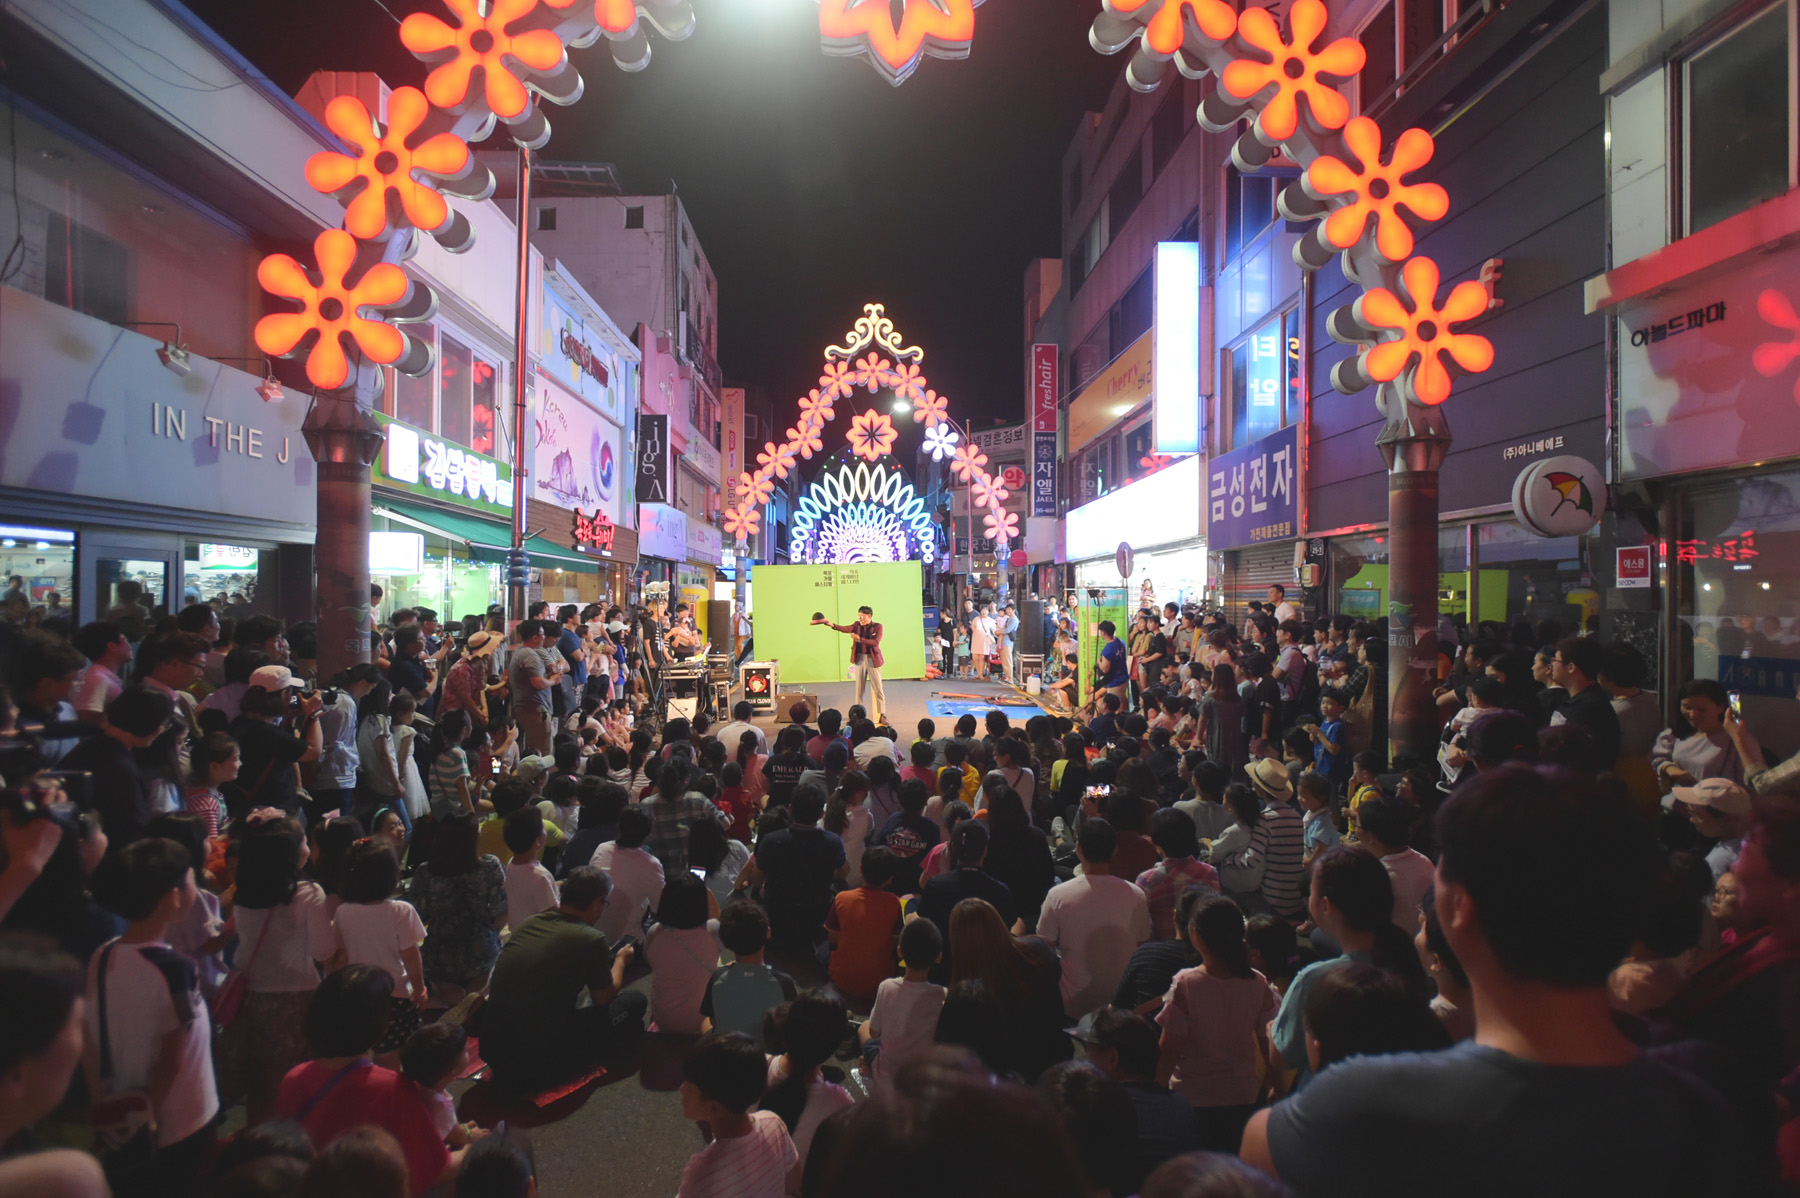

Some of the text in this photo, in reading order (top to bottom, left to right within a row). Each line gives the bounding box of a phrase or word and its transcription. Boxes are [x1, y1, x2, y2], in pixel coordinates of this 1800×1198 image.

[541, 388, 568, 432] Korea
[153, 402, 289, 464] IN THE J
[1004, 470, 1023, 488] 약
[1036, 461, 1054, 495] 자엘
[1211, 445, 1293, 523] 금성전자
[1250, 521, 1291, 541] 가전제품전문점
[1623, 558, 1645, 569] 에스원
